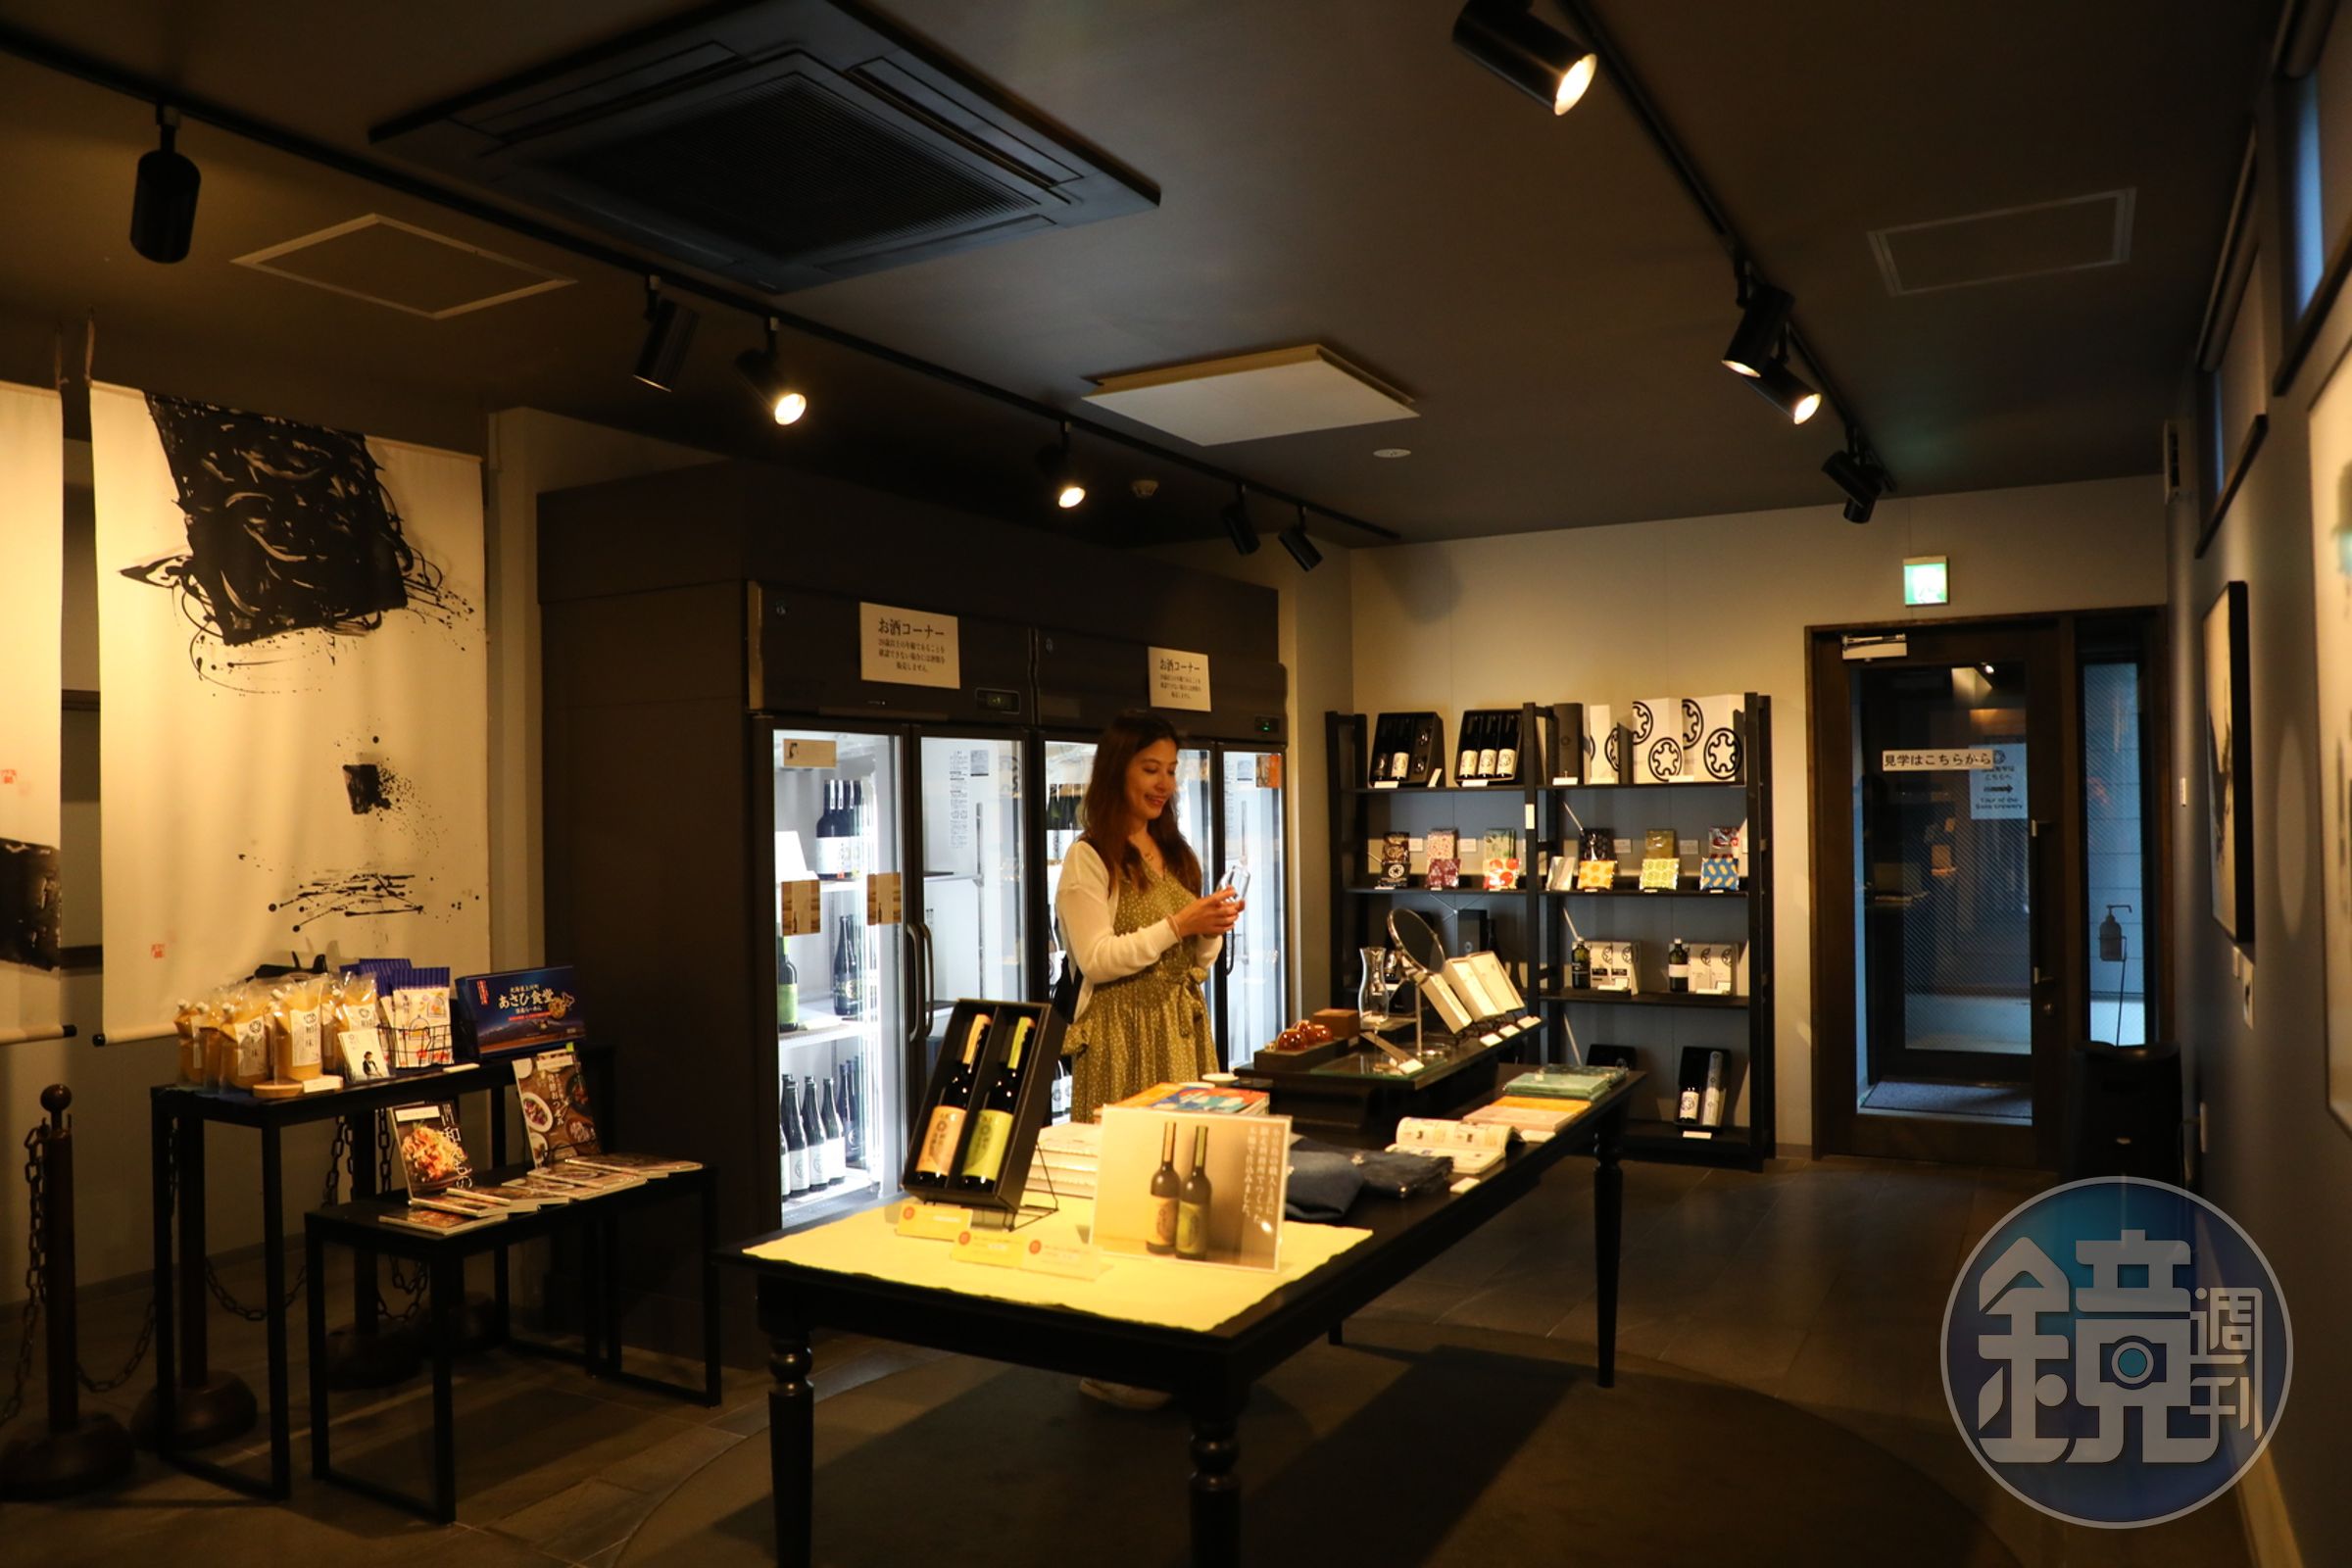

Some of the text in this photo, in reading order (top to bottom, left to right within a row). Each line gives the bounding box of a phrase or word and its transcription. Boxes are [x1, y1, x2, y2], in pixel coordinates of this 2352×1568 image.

[878, 617, 945, 640] お酒コーナー
[1159, 658, 1200, 674] お酒コーナー
[1884, 752, 1991, 767] 見学はこちらから
[498, 988, 555, 1010] あさひ食堂
